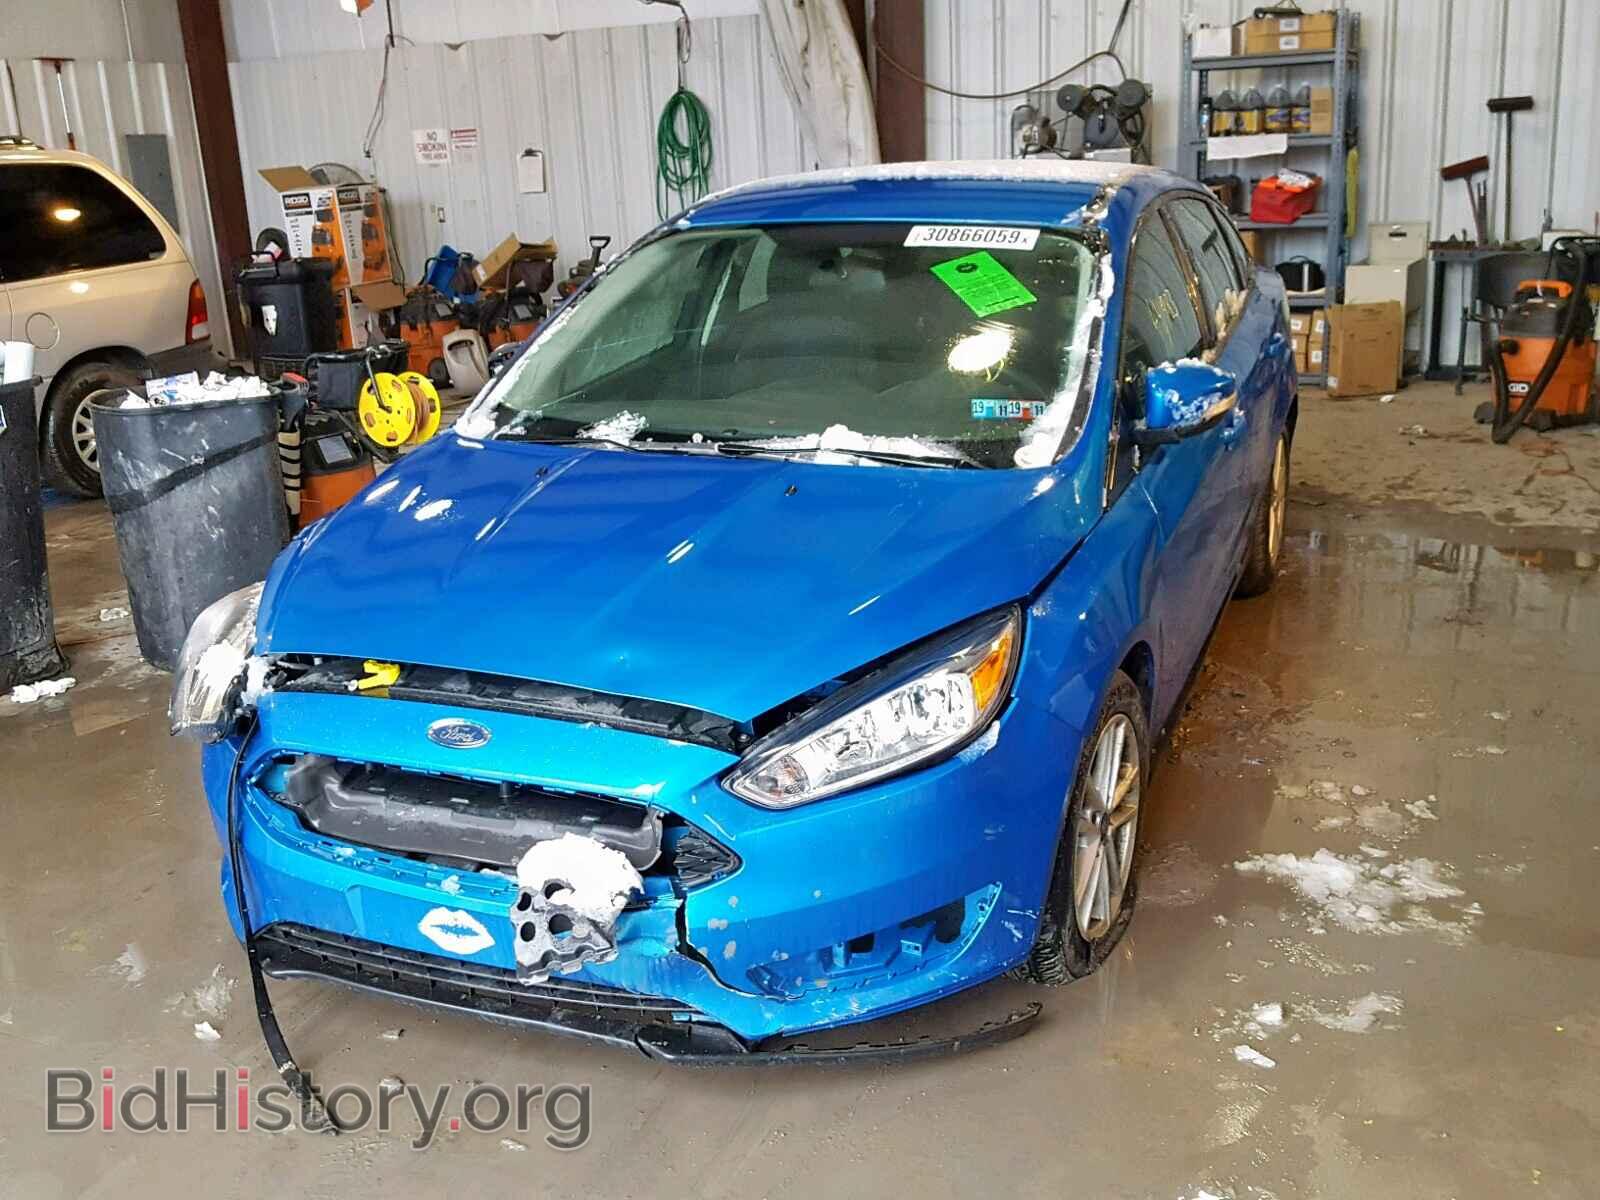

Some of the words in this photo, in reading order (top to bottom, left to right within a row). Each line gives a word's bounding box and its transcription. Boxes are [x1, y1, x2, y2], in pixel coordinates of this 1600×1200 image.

[426, 131, 438, 142] NO
[923, 227, 1020, 244] 30866059
[973, 401, 984, 413] 19
[1009, 402, 1021, 414] 19
[439, 725, 479, 742] Ford
